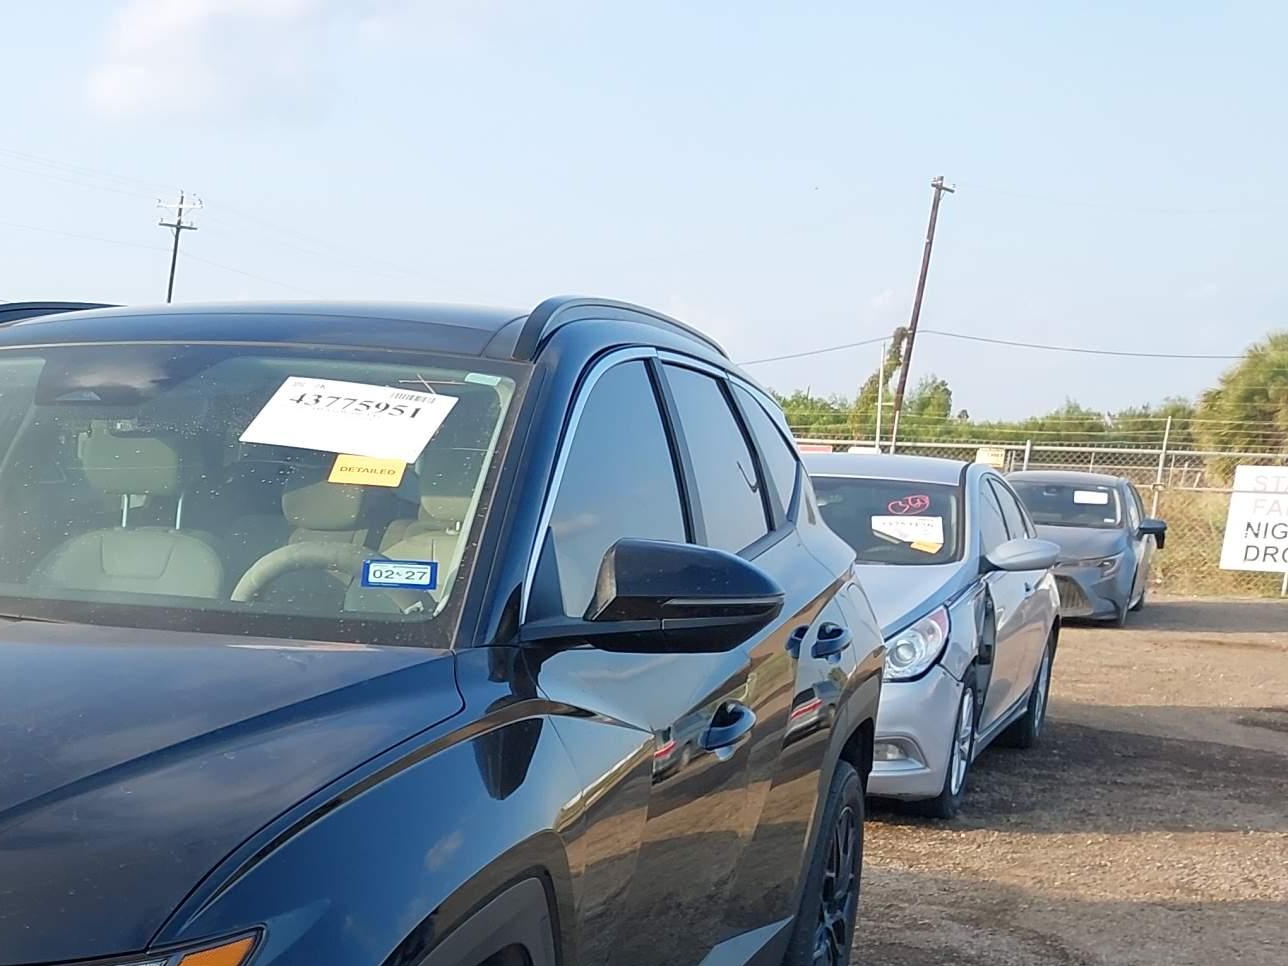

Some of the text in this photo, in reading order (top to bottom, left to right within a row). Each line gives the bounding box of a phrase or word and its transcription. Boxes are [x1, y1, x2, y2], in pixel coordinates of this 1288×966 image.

[288, 392, 422, 419] 43775951
[339, 465, 396, 477] DETAILED
[1253, 474, 1288, 493] ST
[1252, 498, 1288, 517] FA
[1244, 521, 1288, 540] NIG
